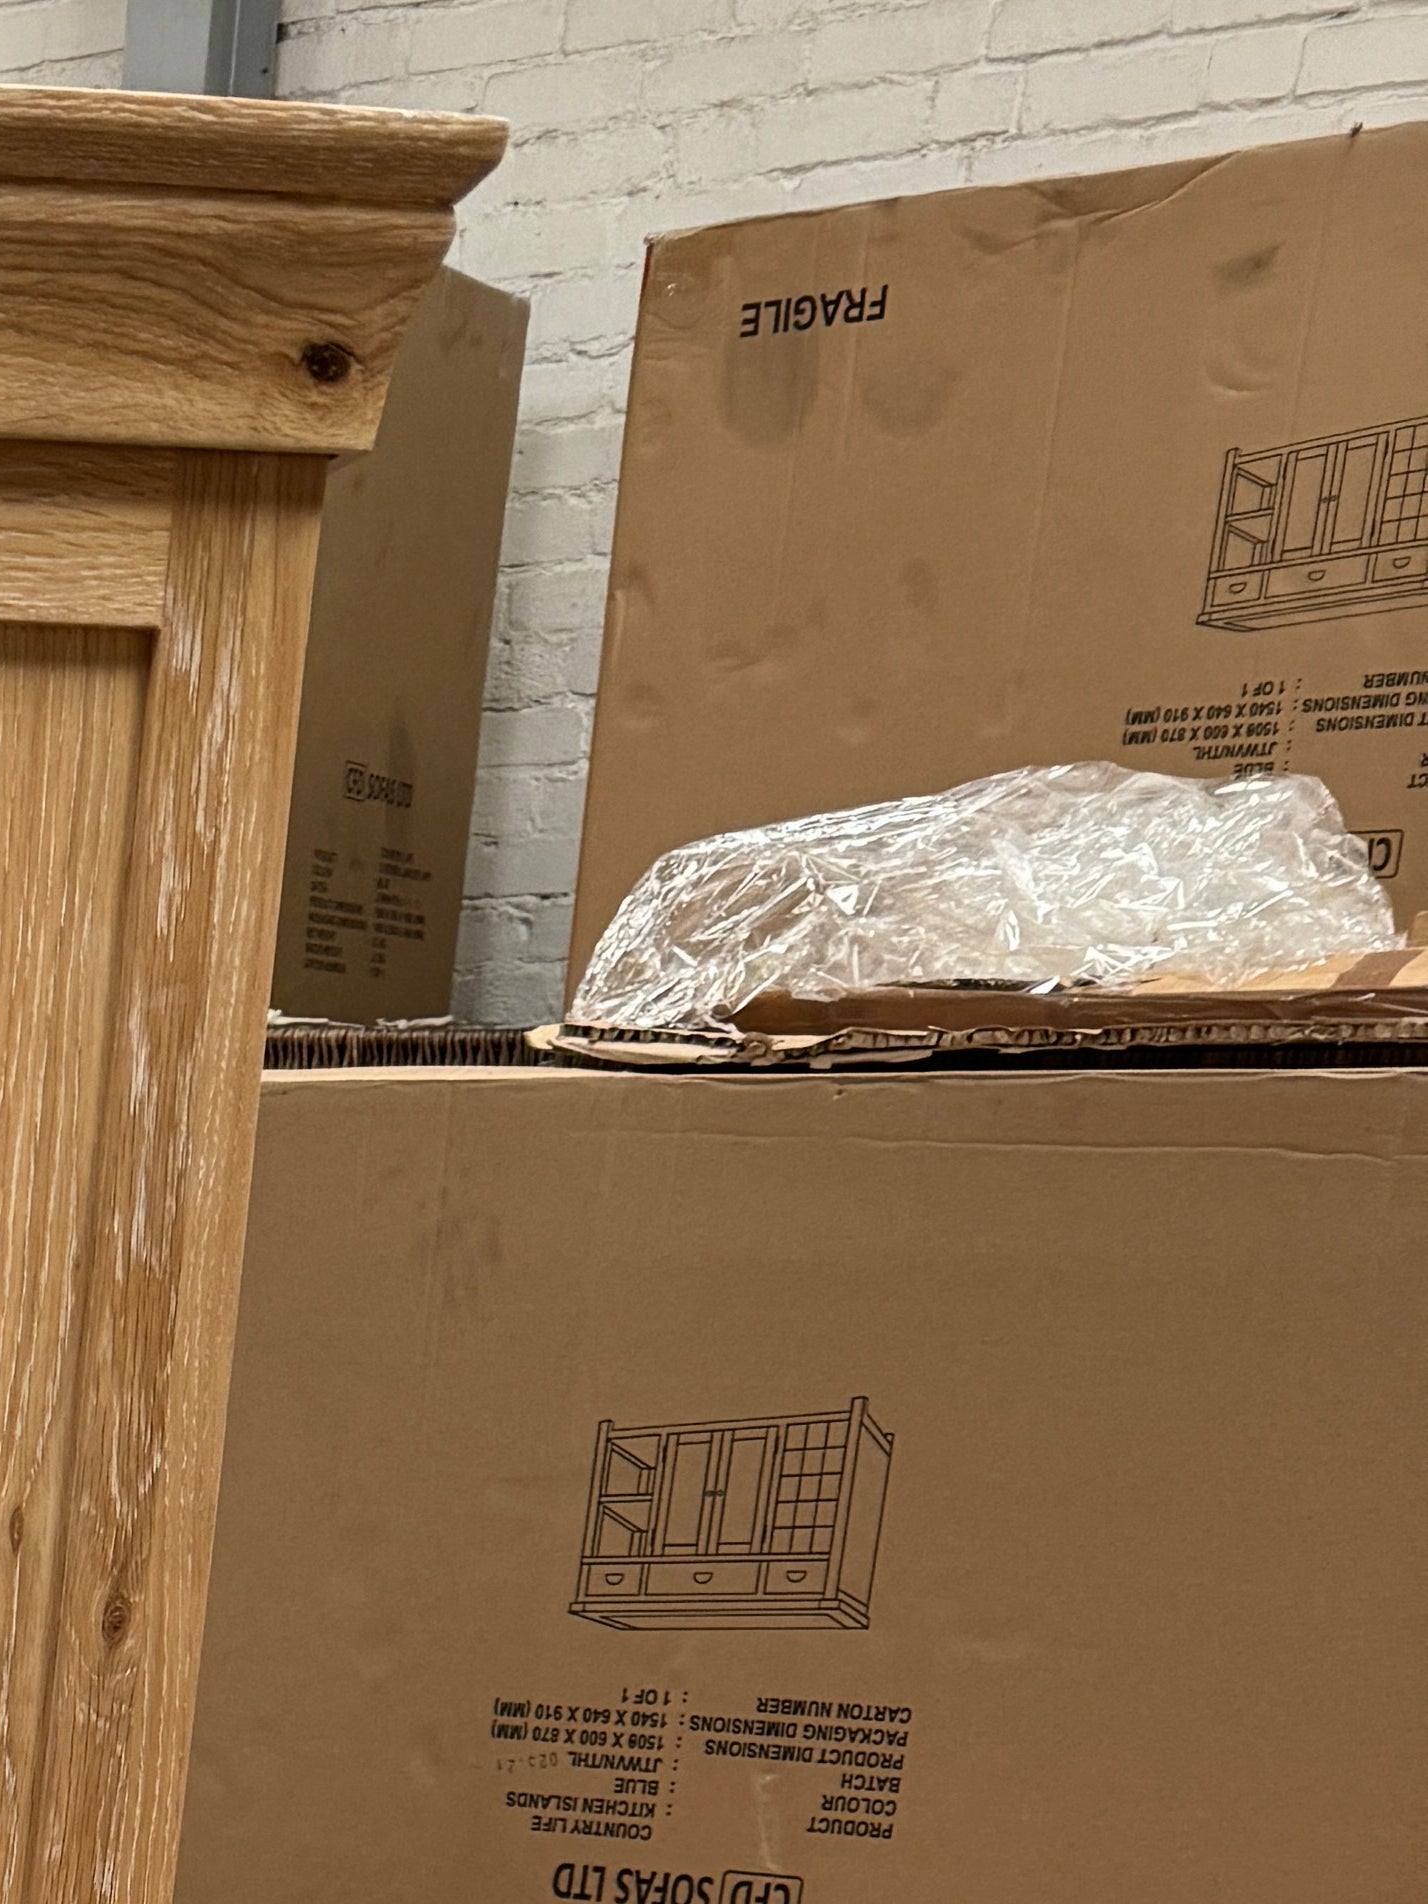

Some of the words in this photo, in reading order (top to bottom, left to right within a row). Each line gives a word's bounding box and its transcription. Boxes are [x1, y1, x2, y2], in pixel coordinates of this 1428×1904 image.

[739, 284, 889, 338] FRAGILE
[1253, 682, 1273, 696] OF
[1250, 701, 1283, 717] 1540
[1302, 693, 1400, 713] DIMENSIONS
[1163, 707, 1189, 724] 910
[1316, 712, 1415, 732] DIMENSIONS
[621, 1688, 629, 1703] 1
[634, 1689, 658, 1705] OF
[663, 1691, 672, 1706] 1
[493, 1698, 531, 1718] (MM)
[535, 1704, 562, 1720] 910
[567, 1707, 579, 1721] X
[583, 1708, 611, 1723] 640
[756, 1697, 833, 1717] NUMBER
[837, 1703, 912, 1723] CARTON
[615, 1710, 628, 1725] X
[632, 1712, 667, 1728] 1540
[689, 1715, 797, 1738] DIMENSIONS
[491, 1720, 528, 1740] (MM)
[532, 1727, 559, 1742] 870
[564, 1729, 576, 1743] X
[581, 1730, 608, 1746] 600
[803, 1724, 908, 1747] PACKAGING
[612, 1732, 624, 1748] X
[704, 1739, 813, 1763] DIMENSIONS
[817, 1748, 904, 1770] PRODUCT
[568, 1752, 662, 1773] JTWVN/THL
[614, 1778, 659, 1795] BLUE
[841, 1773, 901, 1793] BATCH
[505, 1792, 577, 1809] ISLANDS
[582, 1798, 655, 1818] KITCHEN
[821, 1795, 897, 1817] COLOUR
[531, 1816, 567, 1833] LIFE
[570, 1820, 652, 1840] COUNTRY
[806, 1817, 894, 1840] PRODUCT
[552, 1862, 605, 1903] LTD
